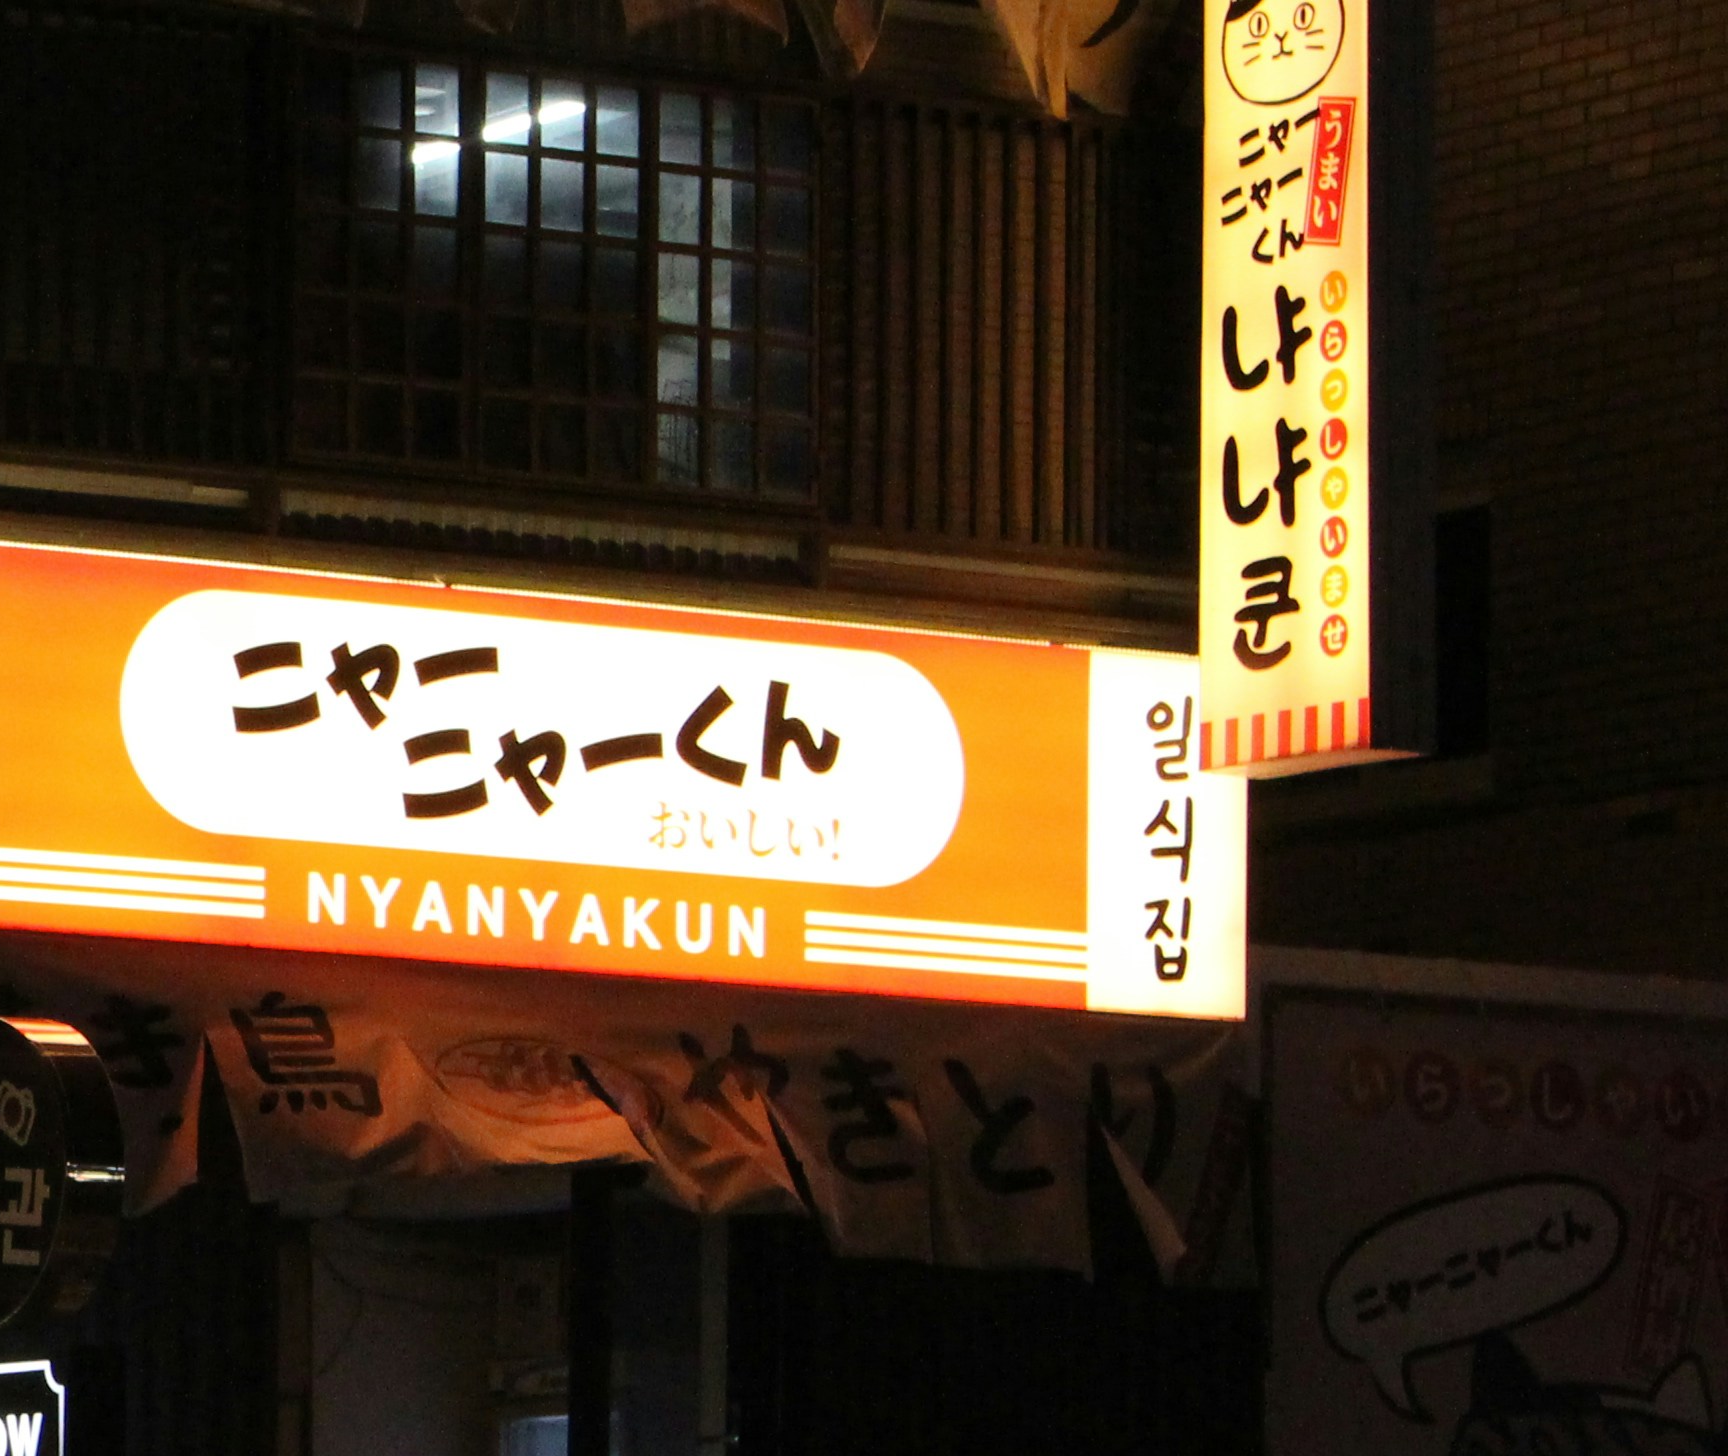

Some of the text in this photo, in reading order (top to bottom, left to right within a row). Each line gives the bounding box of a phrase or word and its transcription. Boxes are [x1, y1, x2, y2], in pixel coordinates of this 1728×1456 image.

[1312, 109, 1344, 229] うまい
[1221, 284, 1313, 671] 냐냐쿤
[1320, 271, 1348, 656] いらっしゃいませ
[308, 872, 768, 958] NYANYAKUN
[1144, 696, 1193, 982] 일식집
